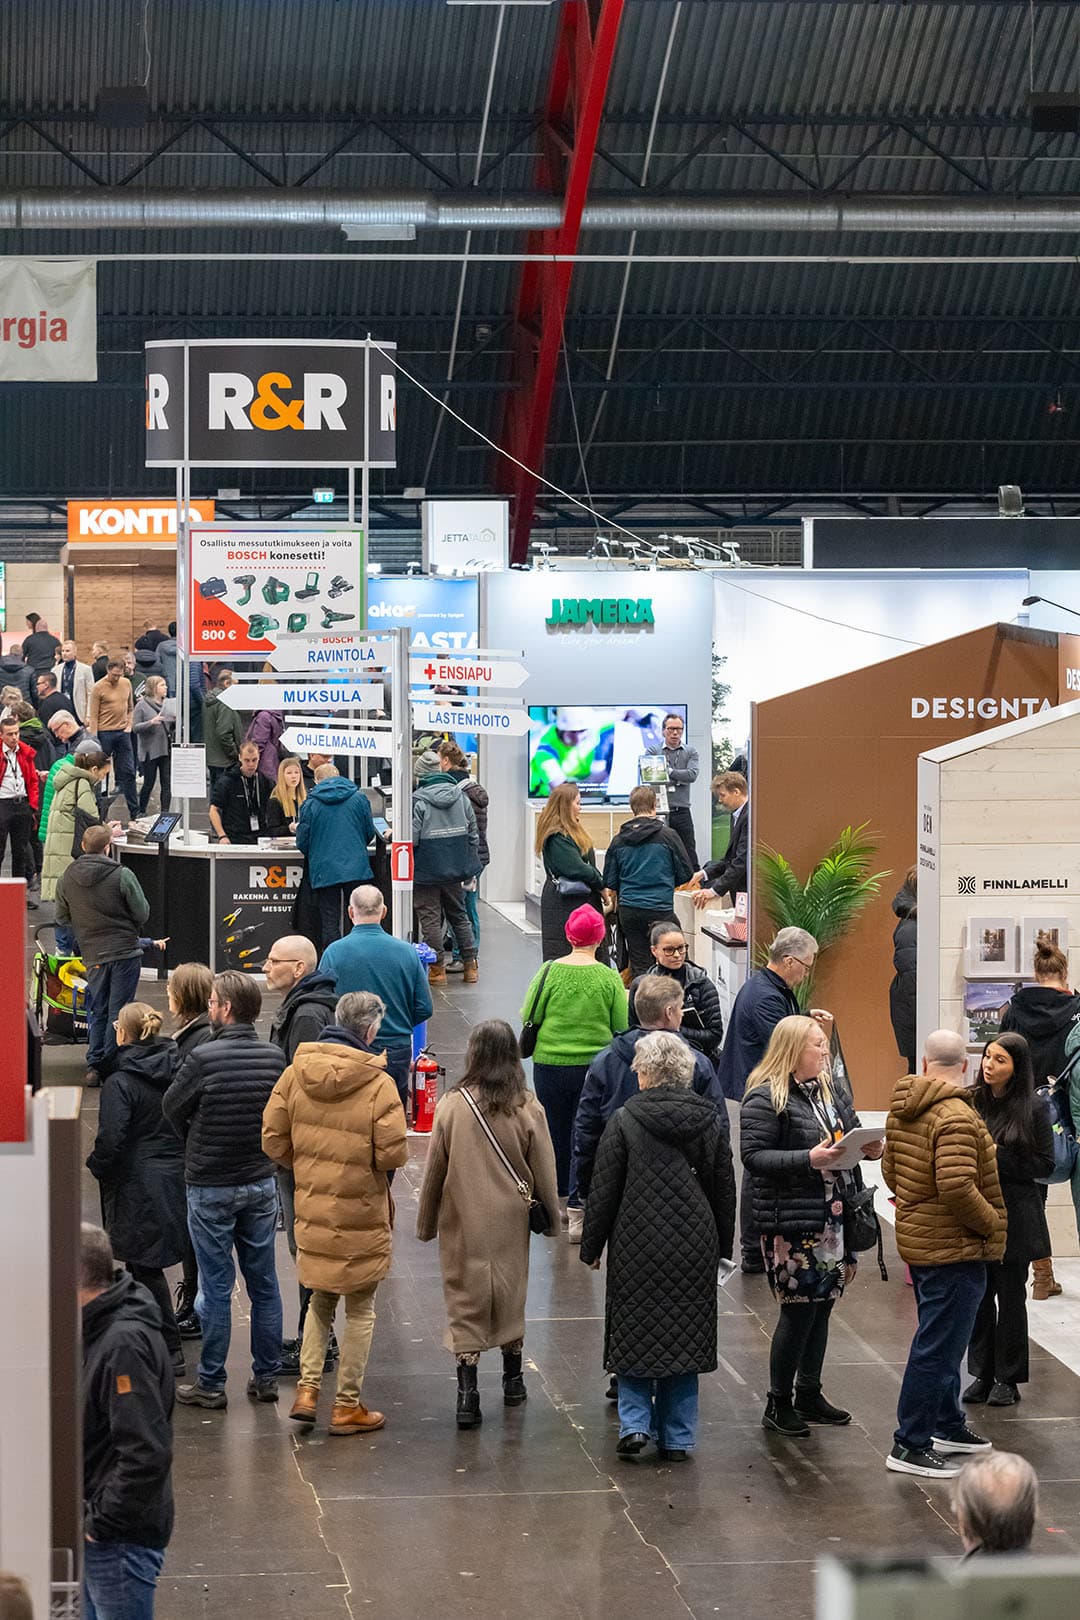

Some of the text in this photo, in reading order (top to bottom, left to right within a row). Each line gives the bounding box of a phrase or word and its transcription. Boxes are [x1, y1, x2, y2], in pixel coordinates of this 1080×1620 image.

[0, 310, 68, 349] rgia
[208, 371, 348, 431] R&R
[322, 540, 330, 549] ja
[227, 551, 326, 560] BOSCH konesetti!
[202, 619, 225, 627] ARVO
[201, 630, 237, 641] 800 €
[308, 648, 375, 663] RAVINTOLA
[439, 665, 492, 681] ENSIAPU
[284, 690, 361, 702] MUKSULA
[428, 711, 510, 728] LASTENHOITO
[297, 733, 377, 749] OHJELMALAVA
[249, 865, 303, 888] R&R
[983, 879, 1068, 890] FINNLAMELLI
